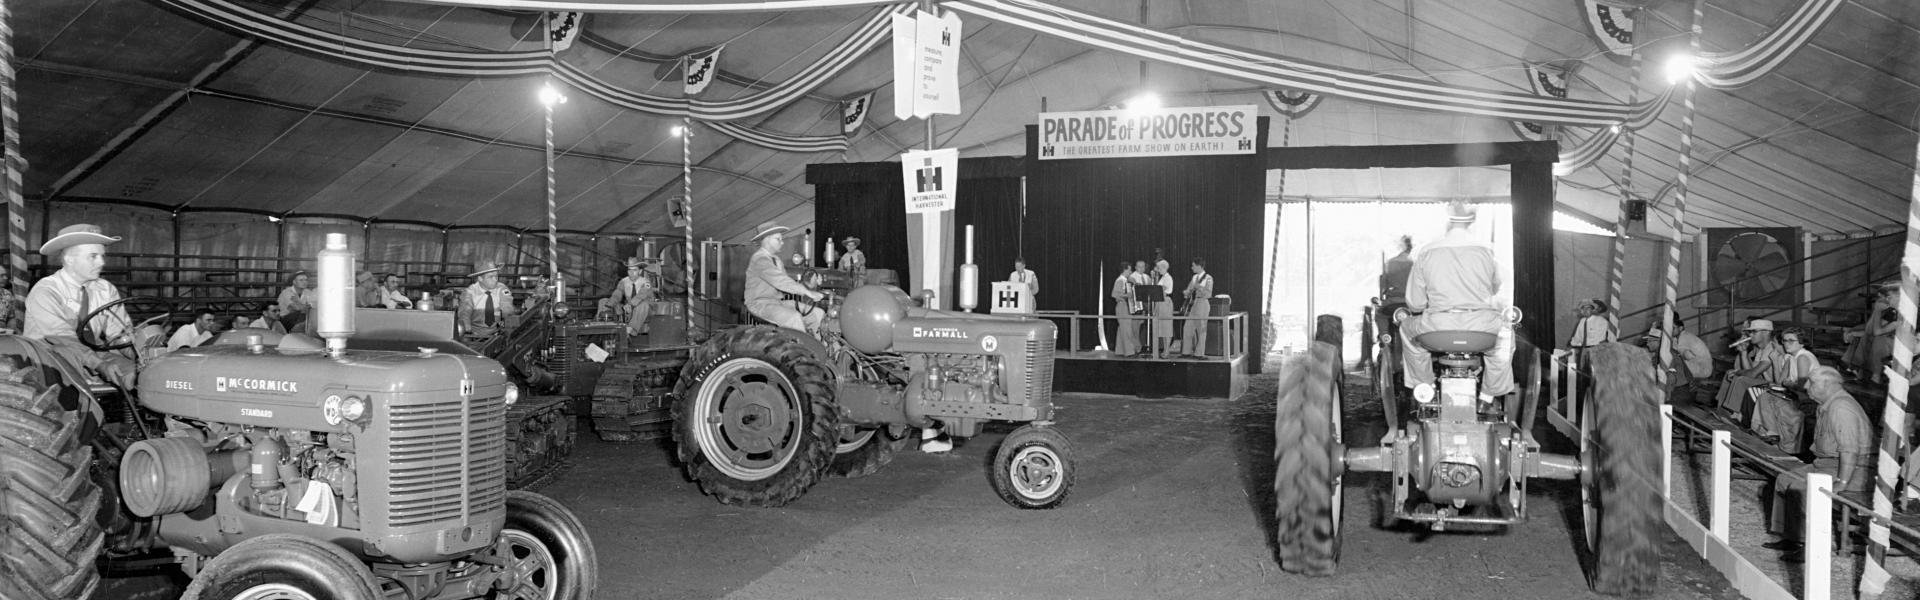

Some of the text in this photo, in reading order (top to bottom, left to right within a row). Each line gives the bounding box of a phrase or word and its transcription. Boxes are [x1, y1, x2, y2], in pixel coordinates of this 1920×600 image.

[1044, 111, 1245, 142] PARADE of PROGRESS
[1063, 145, 1075, 155] THE
[1079, 145, 1114, 155] GREATEST
[1118, 144, 1141, 153] FARM
[1144, 143, 1171, 152] SHOW
[1174, 142, 1186, 152] ON
[912, 193, 947, 202] INTERNATIONAL
[922, 330, 968, 339] FARMALL
[165, 380, 193, 390] DIESEL
[240, 408, 273, 418] STANDARD
